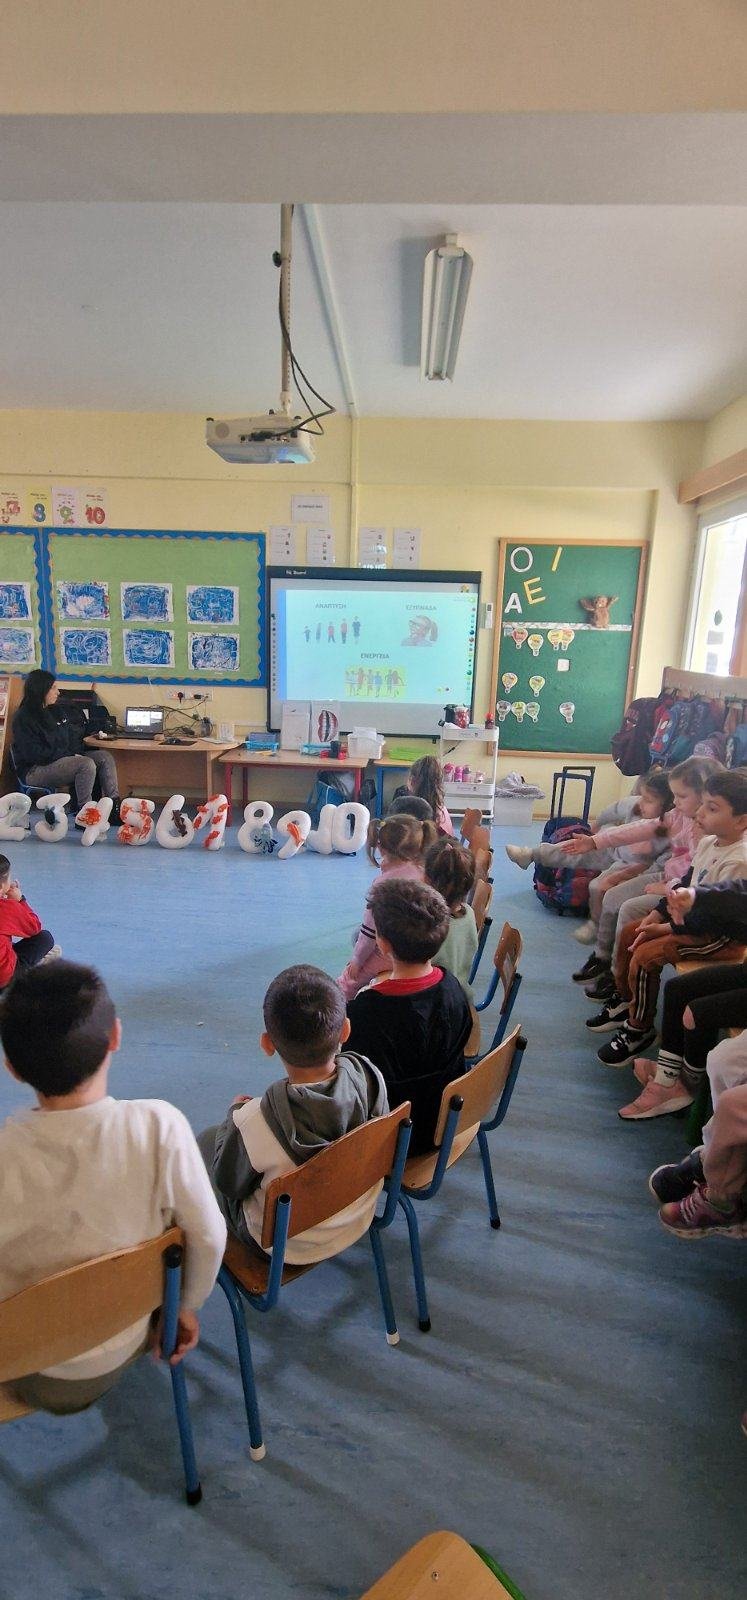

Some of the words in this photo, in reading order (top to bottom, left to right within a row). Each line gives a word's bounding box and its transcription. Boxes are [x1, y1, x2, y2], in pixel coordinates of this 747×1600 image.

[33, 503, 46, 522] 8
[86, 507, 105, 524] 10
[523, 576, 546, 605] E
[504, 592, 523, 614] A
[0, 792, 31, 842] 2
[35, 793, 71, 843] 3
[117, 797, 155, 846] 5
[156, 794, 195, 849] 6
[238, 801, 278, 855] 8
[276, 810, 312, 860] 9
